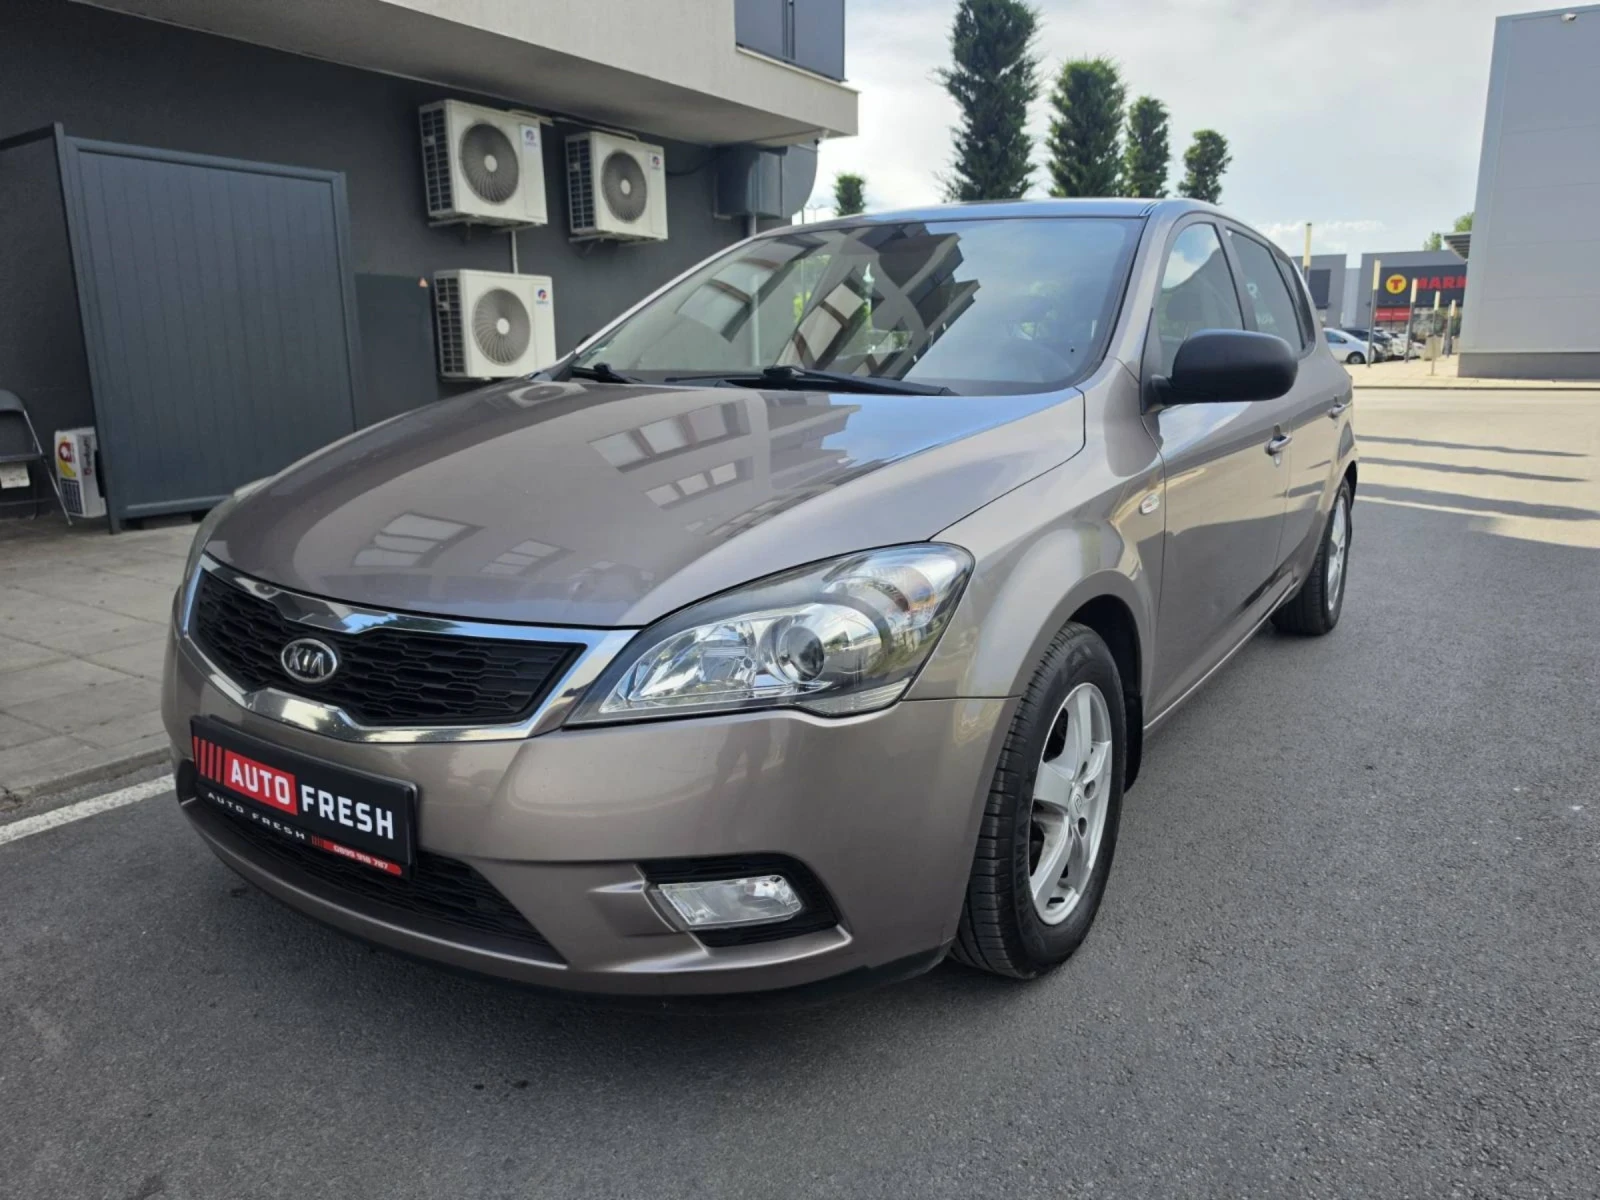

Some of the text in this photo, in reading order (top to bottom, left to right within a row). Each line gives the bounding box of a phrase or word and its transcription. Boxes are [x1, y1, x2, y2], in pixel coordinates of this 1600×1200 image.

[288, 646, 325, 676] KIA
[207, 792, 305, 840] AUTO FRESH
[231, 759, 394, 839] AUTO FRESH
